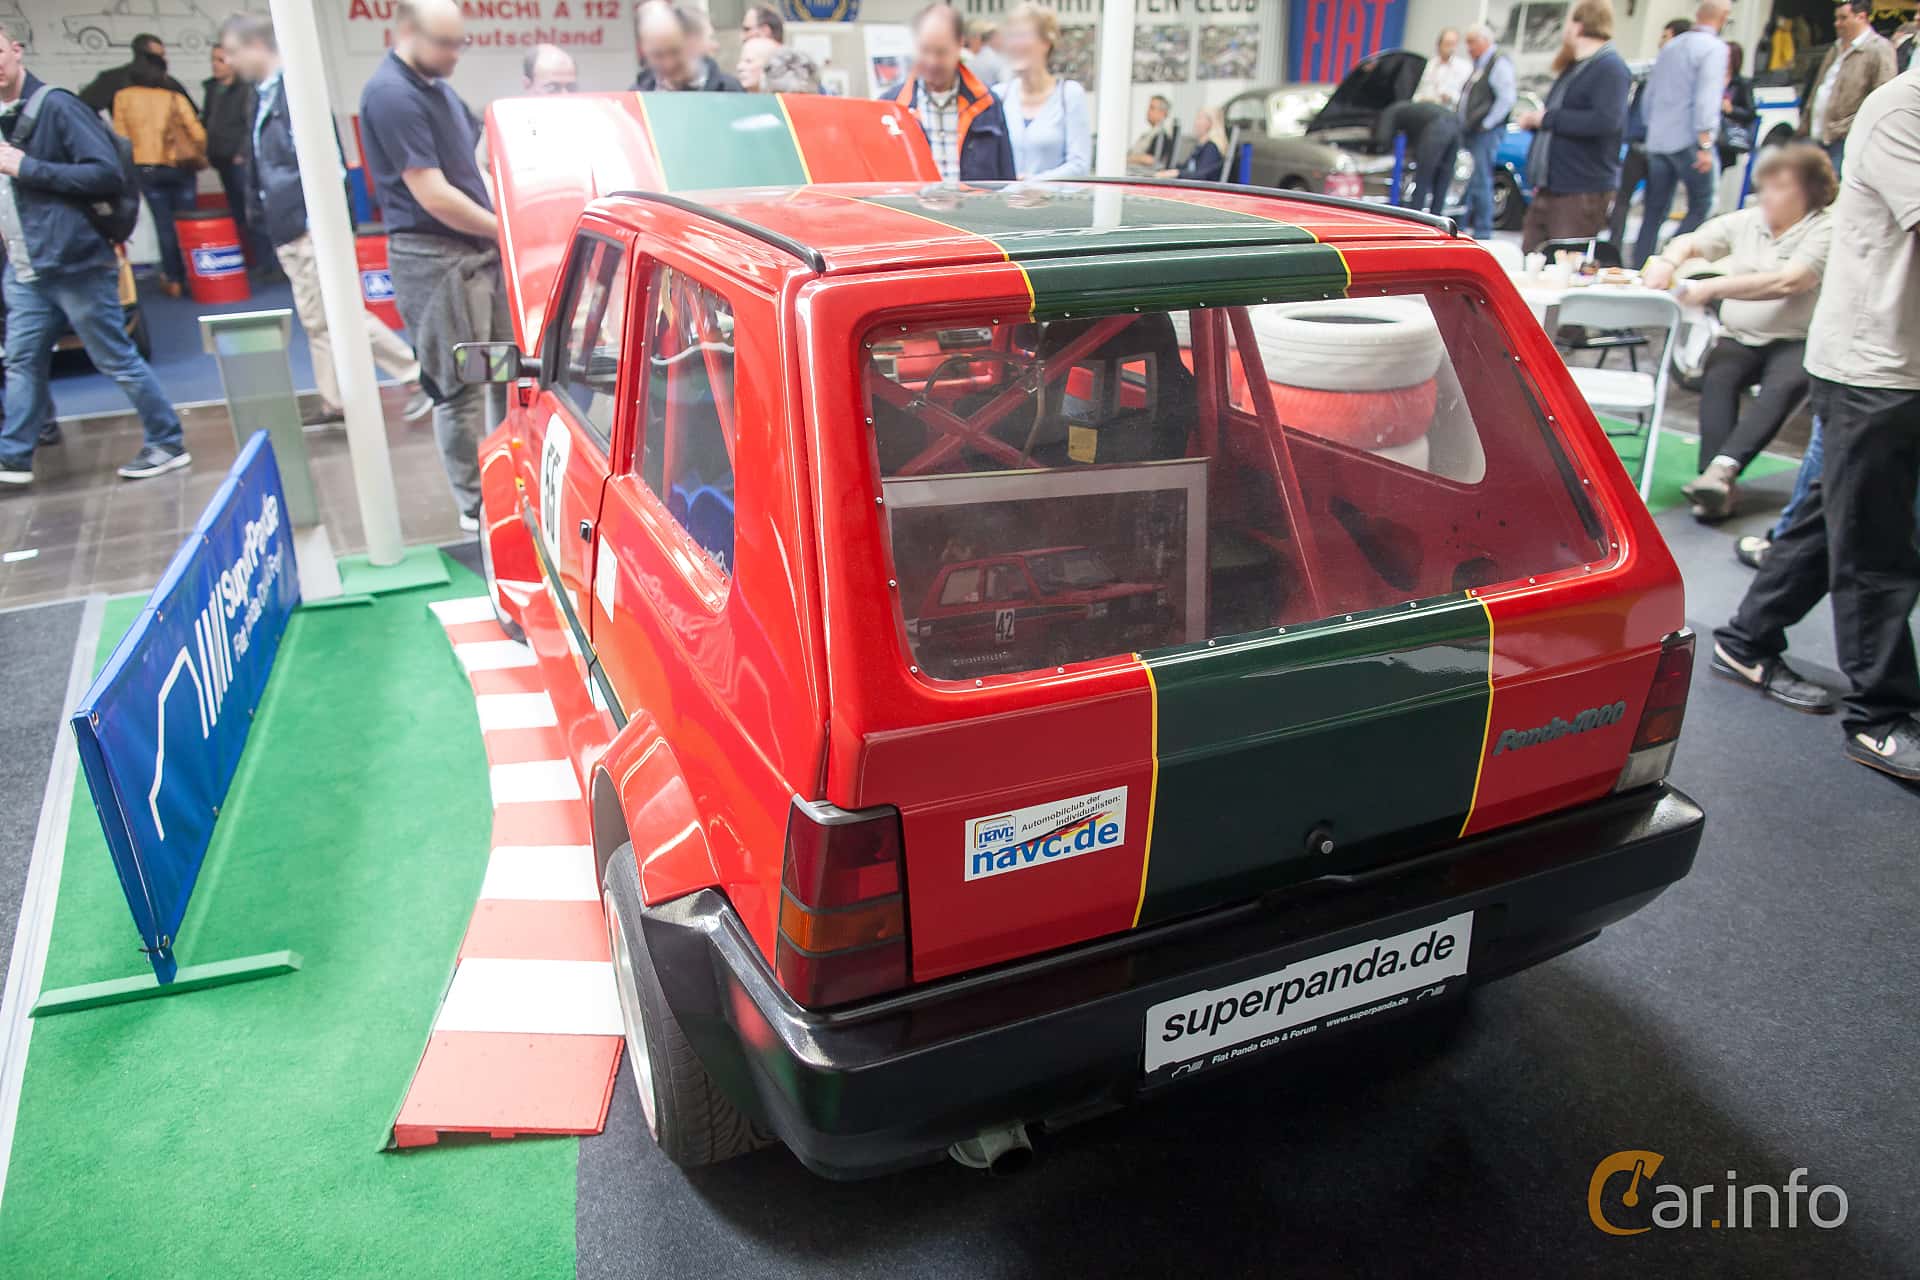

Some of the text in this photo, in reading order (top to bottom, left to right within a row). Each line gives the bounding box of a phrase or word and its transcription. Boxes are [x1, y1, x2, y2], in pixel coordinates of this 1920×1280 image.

[553, 0, 570, 18] A
[584, 0, 619, 19] 112
[996, 610, 1014, 640] 42
[1021, 794, 1101, 832] Automobilclub der
[1055, 795, 1121, 827] Individualisten:
[972, 819, 1120, 875] navc.de
[978, 826, 1014, 845] navc
[1161, 930, 1456, 1042] superpanda.de
[1211, 996, 1409, 1065] Fiat Panda Club & Forum www.superpanda.de
